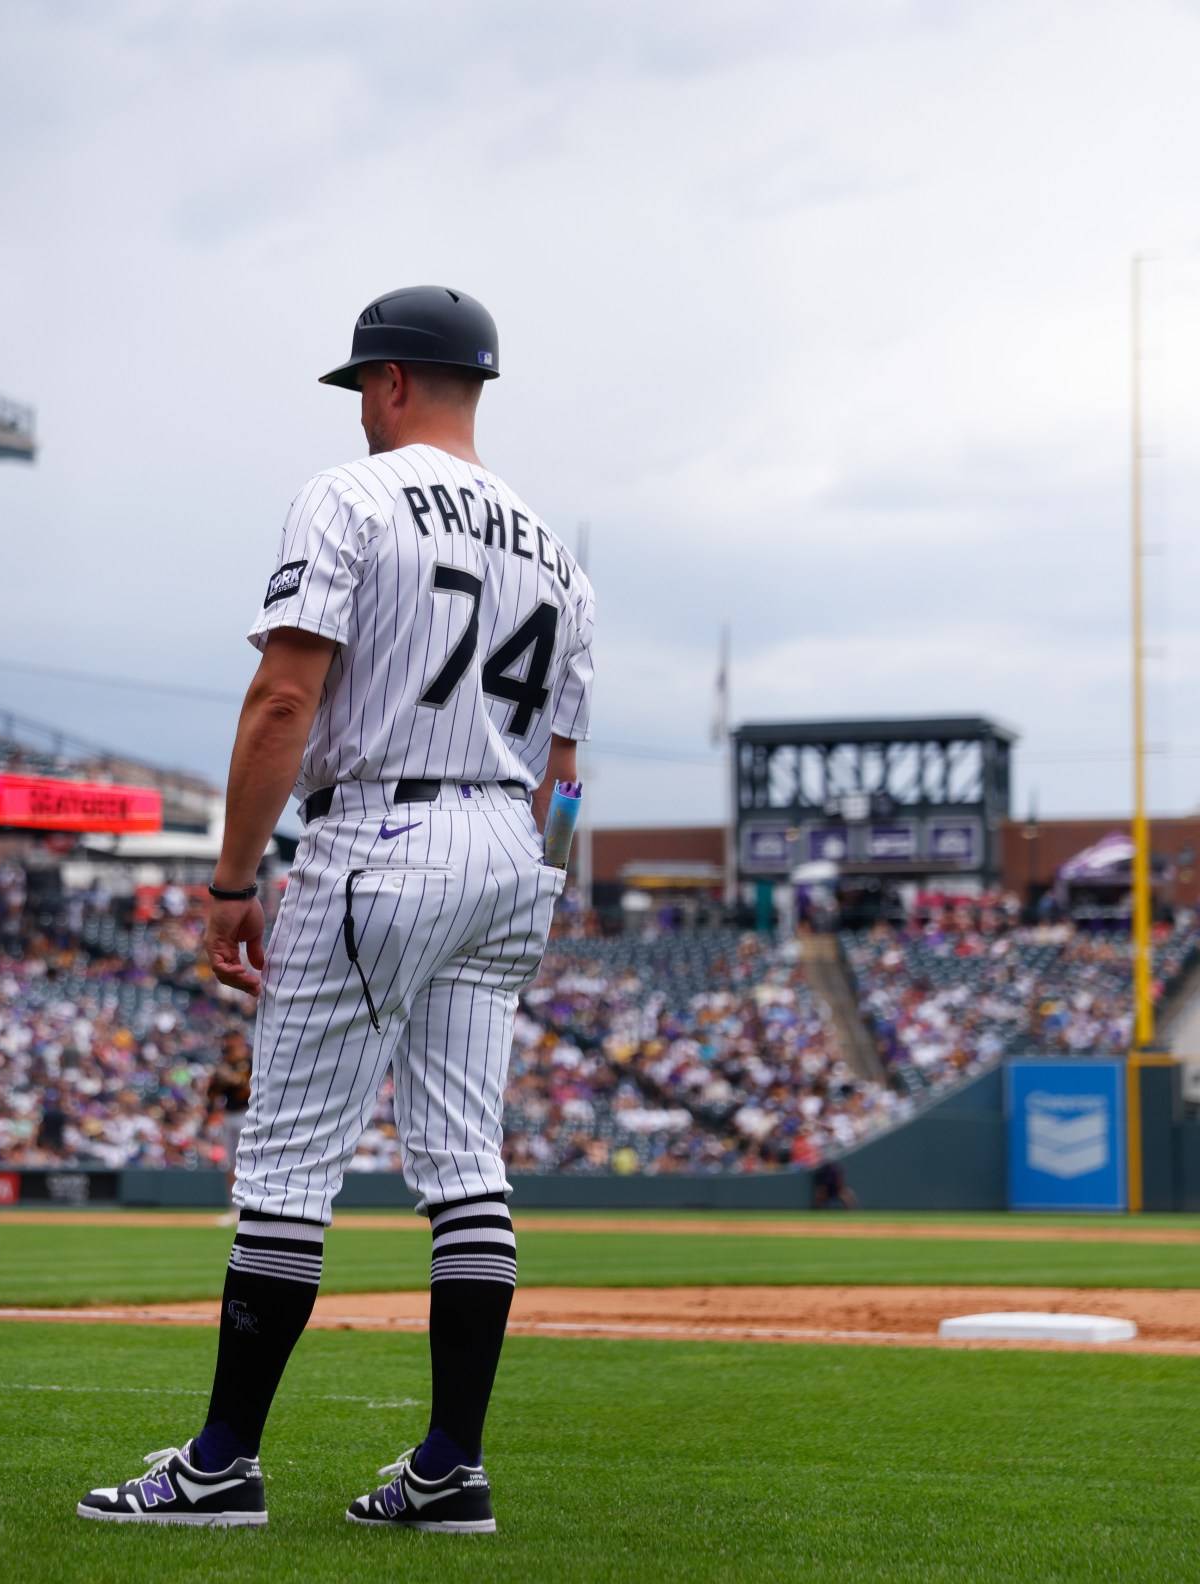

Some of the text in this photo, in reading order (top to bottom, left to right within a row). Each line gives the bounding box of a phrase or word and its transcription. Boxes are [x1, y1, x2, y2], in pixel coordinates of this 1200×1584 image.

[270, 565, 305, 593] YORK
[401, 484, 571, 592] PACHECO
[413, 561, 560, 742] 74
